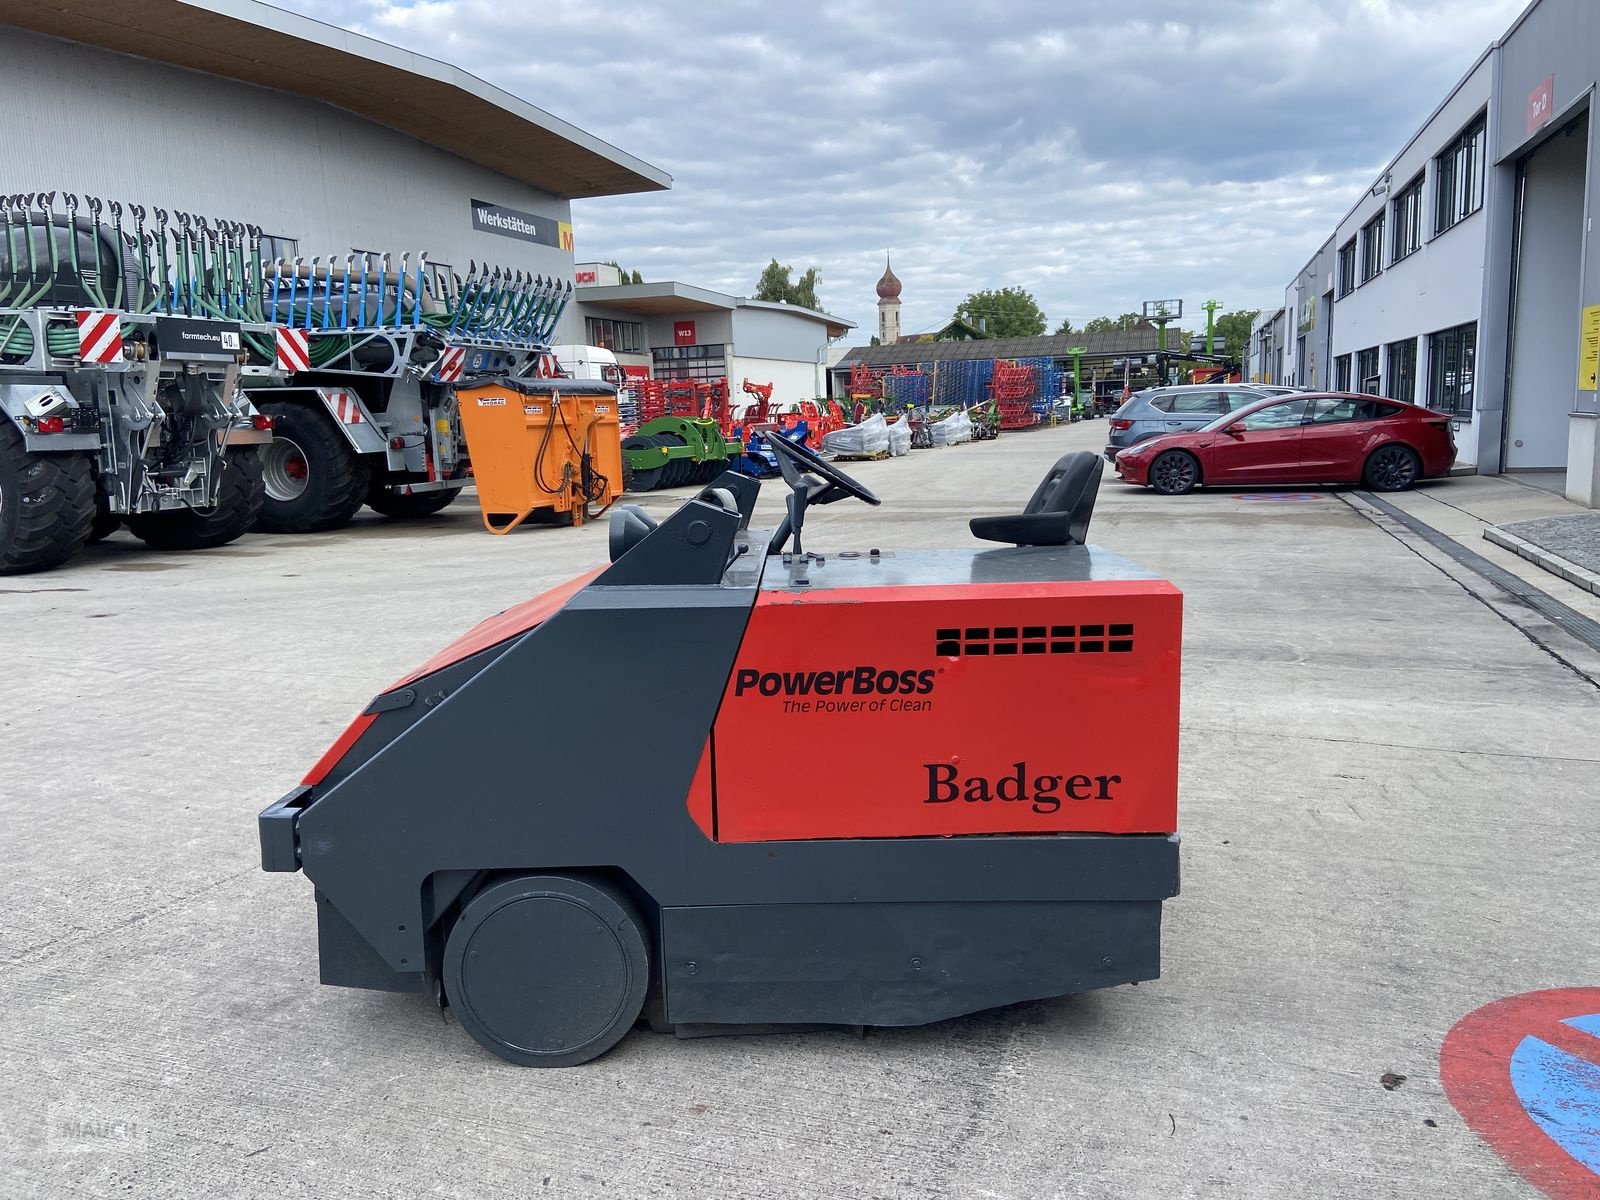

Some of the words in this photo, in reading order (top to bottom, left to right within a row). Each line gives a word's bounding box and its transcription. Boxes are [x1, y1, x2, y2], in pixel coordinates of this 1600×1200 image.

[1533, 101, 1541, 119] Tor
[1542, 93, 1547, 110] D
[477, 207, 536, 236] Werkstätten
[563, 231, 574, 252] M
[182, 331, 220, 342] farmtech.eu
[223, 334, 233, 348] 40
[678, 329, 692, 337] W13
[735, 666, 936, 697] PowerBoss
[783, 700, 810, 713] The
[816, 700, 866, 713] Power
[869, 699, 887, 712] of
[890, 699, 932, 712] Clean
[923, 761, 1122, 814] Badger
